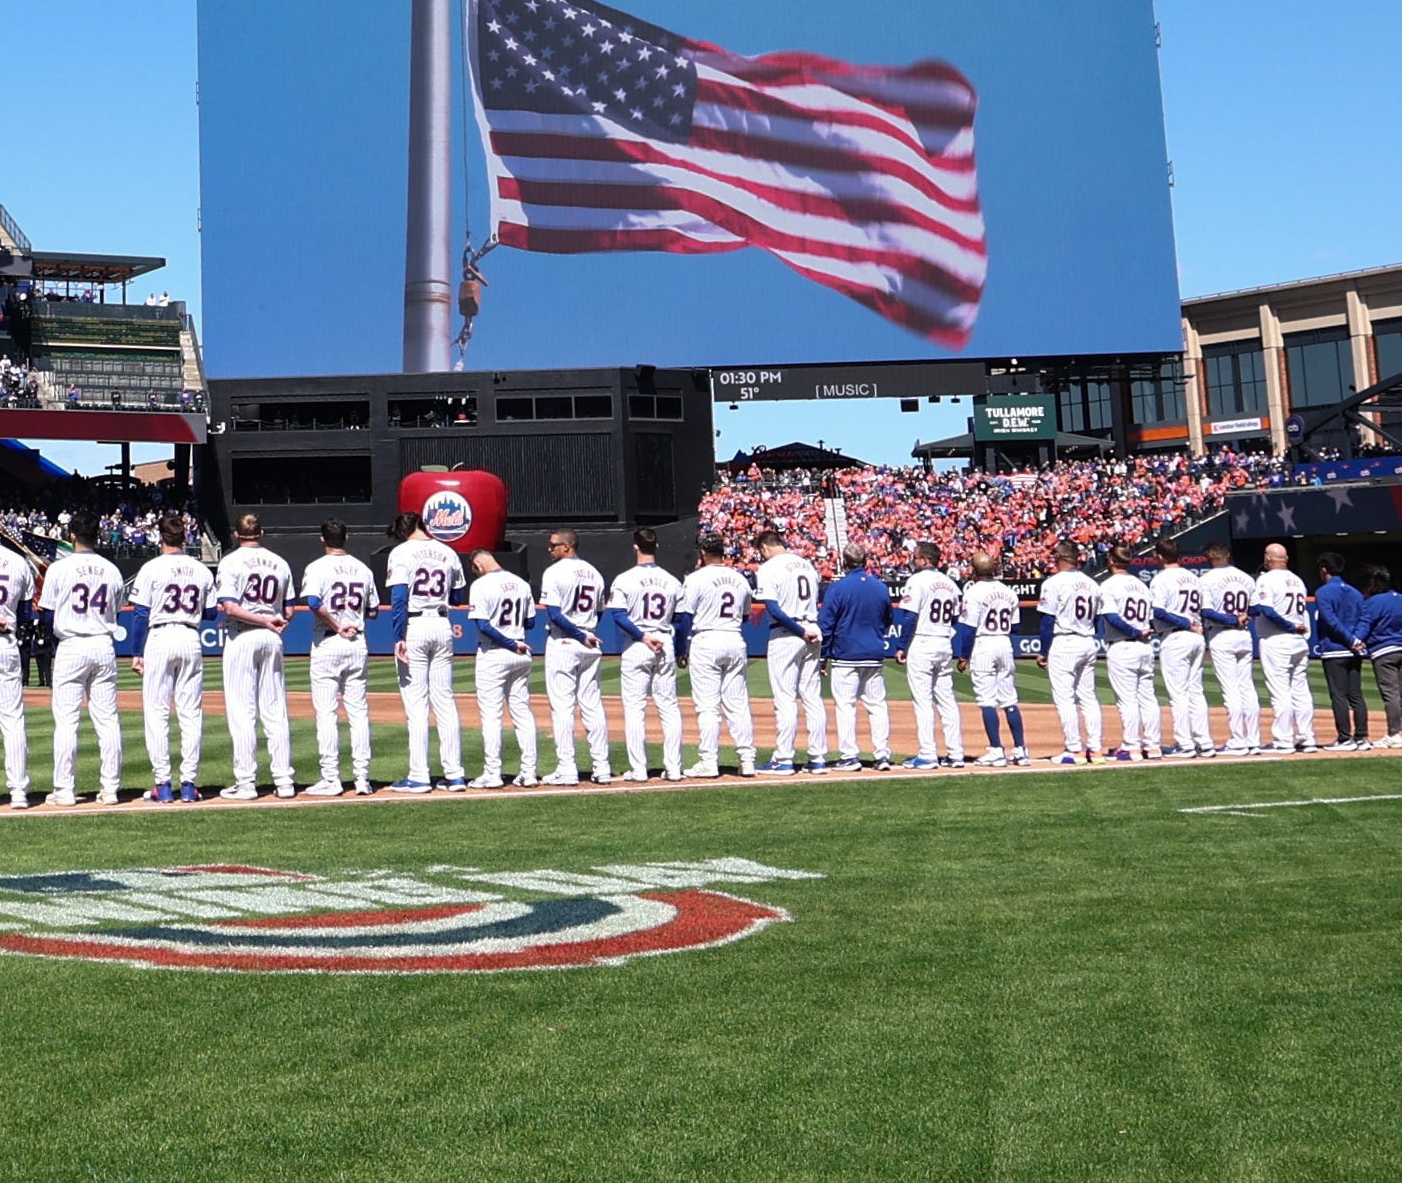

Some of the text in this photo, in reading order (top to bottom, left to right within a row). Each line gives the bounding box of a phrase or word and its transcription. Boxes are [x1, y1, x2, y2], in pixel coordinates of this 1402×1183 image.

[720, 371, 782, 385] 01:30 PM
[823, 384, 870, 397] MUSIC
[985, 406, 1044, 418] TULLAMORE
[430, 509, 464, 527] Mets
[170, 566, 194, 578] SMITH
[412, 567, 446, 598] 23
[72, 583, 108, 615] 34
[164, 583, 200, 614] 33
[245, 573, 279, 604] 30
[330, 582, 364, 611] 25
[571, 585, 595, 613] 15
[797, 575, 811, 601] 0
[498, 597, 521, 626] 21
[642, 592, 666, 620] 13
[719, 591, 735, 618] 2
[929, 598, 954, 623] 88
[1075, 595, 1092, 620] 61
[1124, 597, 1147, 622] 60
[1179, 590, 1200, 613] 79
[1223, 590, 1248, 614] 80
[1285, 593, 1305, 615] 76
[985, 608, 1011, 632] 66
[461, 857, 828, 895] DAY
